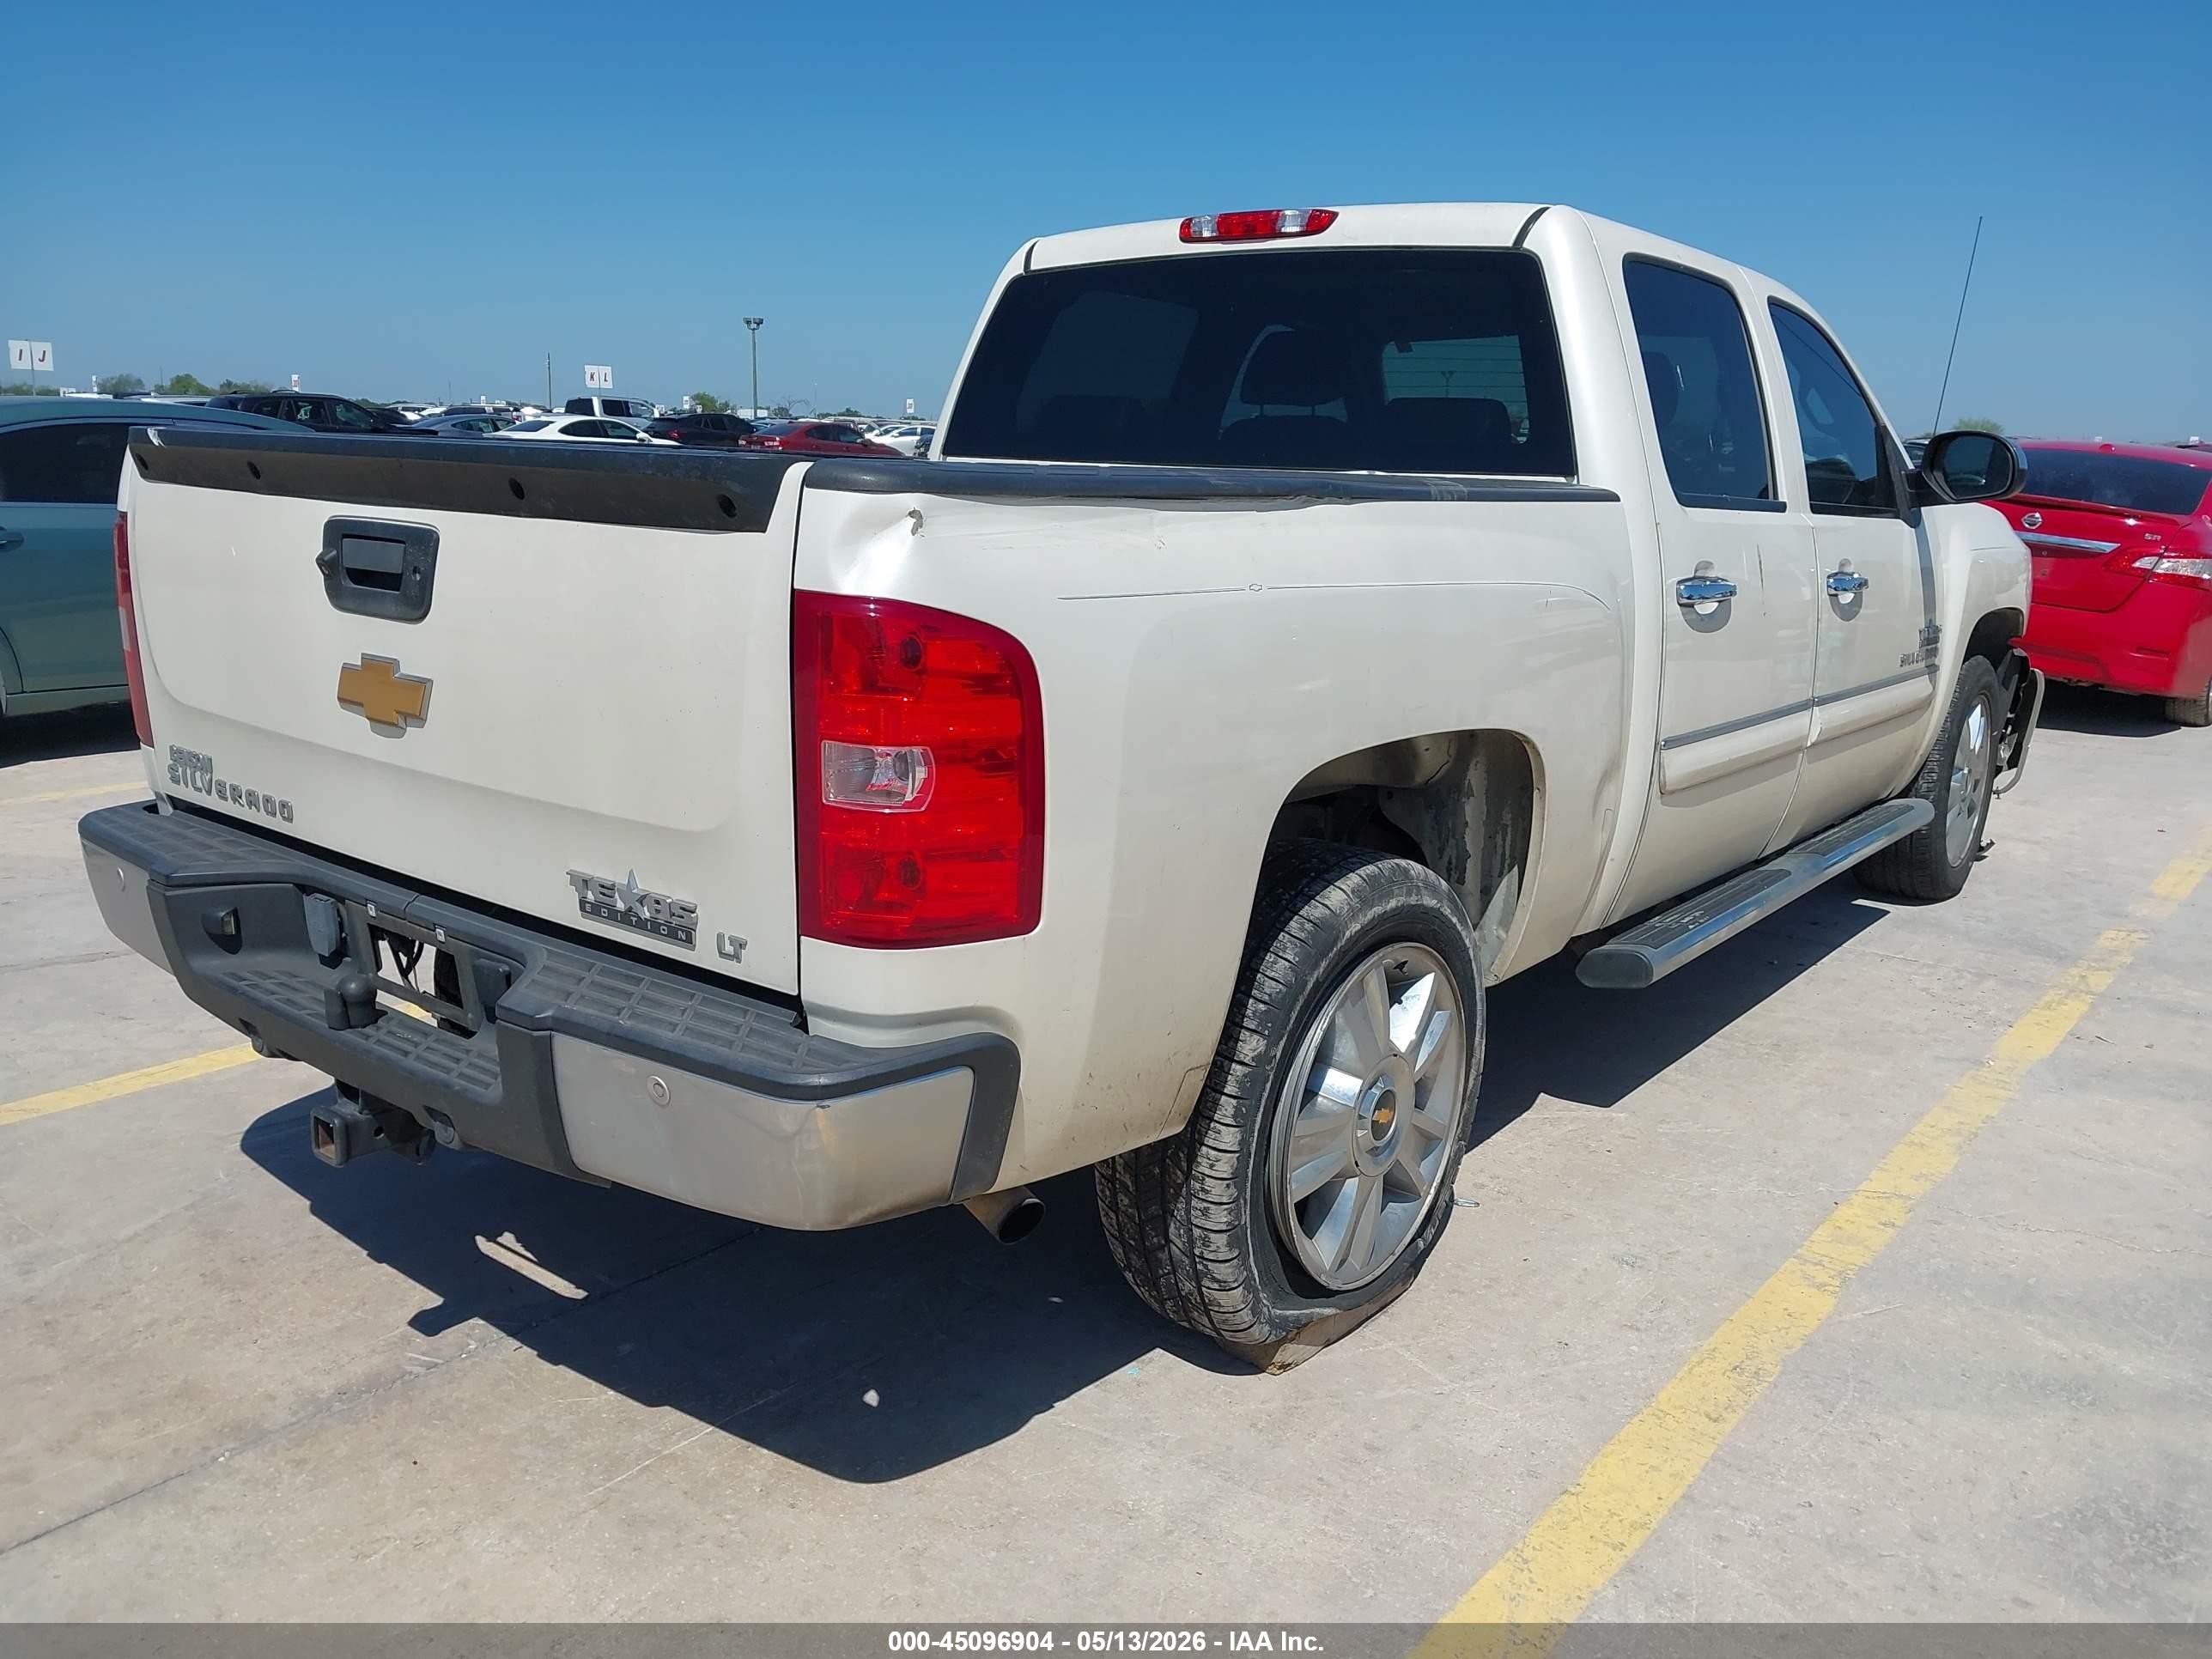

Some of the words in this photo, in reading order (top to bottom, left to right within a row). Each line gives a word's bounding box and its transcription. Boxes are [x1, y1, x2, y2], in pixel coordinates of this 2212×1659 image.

[38, 349, 46, 362] J
[589, 371, 596, 382] K
[604, 372, 609, 382] L
[167, 763, 294, 824] SILVERADO
[584, 902, 687, 941] EDITION
[716, 931, 748, 963] LT
